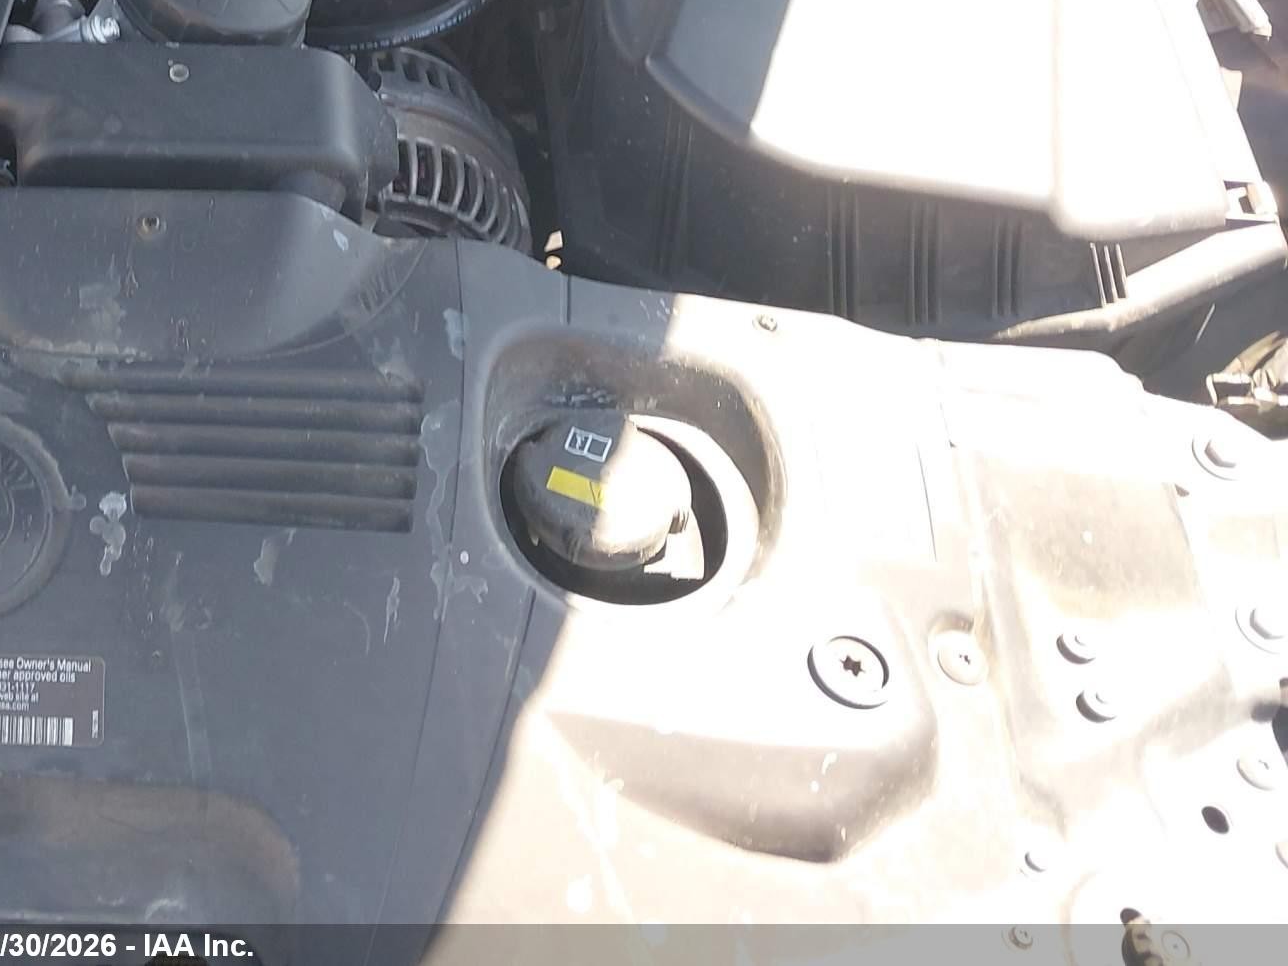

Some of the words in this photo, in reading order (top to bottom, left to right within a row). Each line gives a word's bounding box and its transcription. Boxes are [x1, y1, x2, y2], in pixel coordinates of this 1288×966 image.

[16, 656, 54, 671] Owner's
[57, 658, 91, 673] Manual
[13, 669, 58, 683] approved
[59, 670, 76, 683] oils
